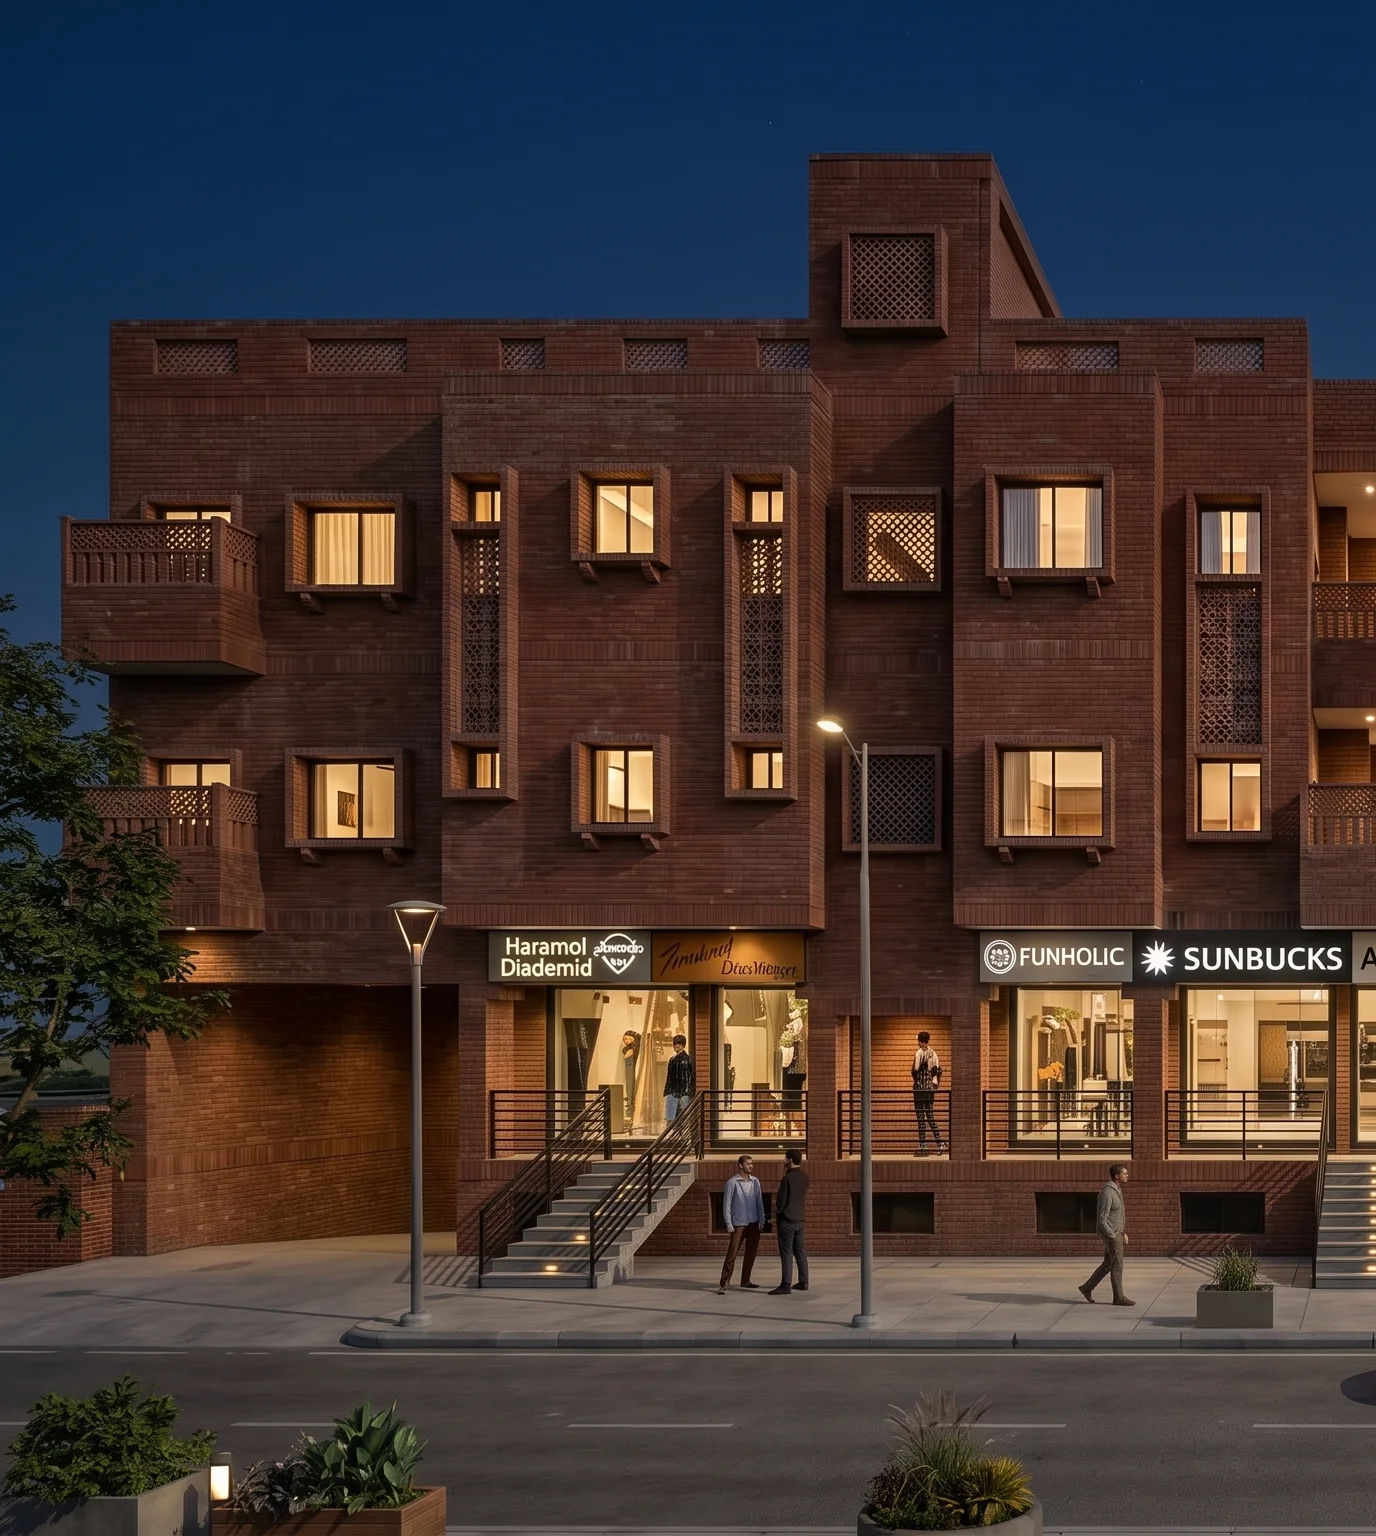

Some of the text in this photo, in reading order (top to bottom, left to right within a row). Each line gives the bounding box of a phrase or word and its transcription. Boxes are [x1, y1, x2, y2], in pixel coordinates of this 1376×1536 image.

[506, 937, 587, 955] Haramol
[1020, 947, 1125, 966] FUNHOLIC
[1184, 947, 1343, 971] SUNBUCKS
[501, 958, 592, 977] Diademid
